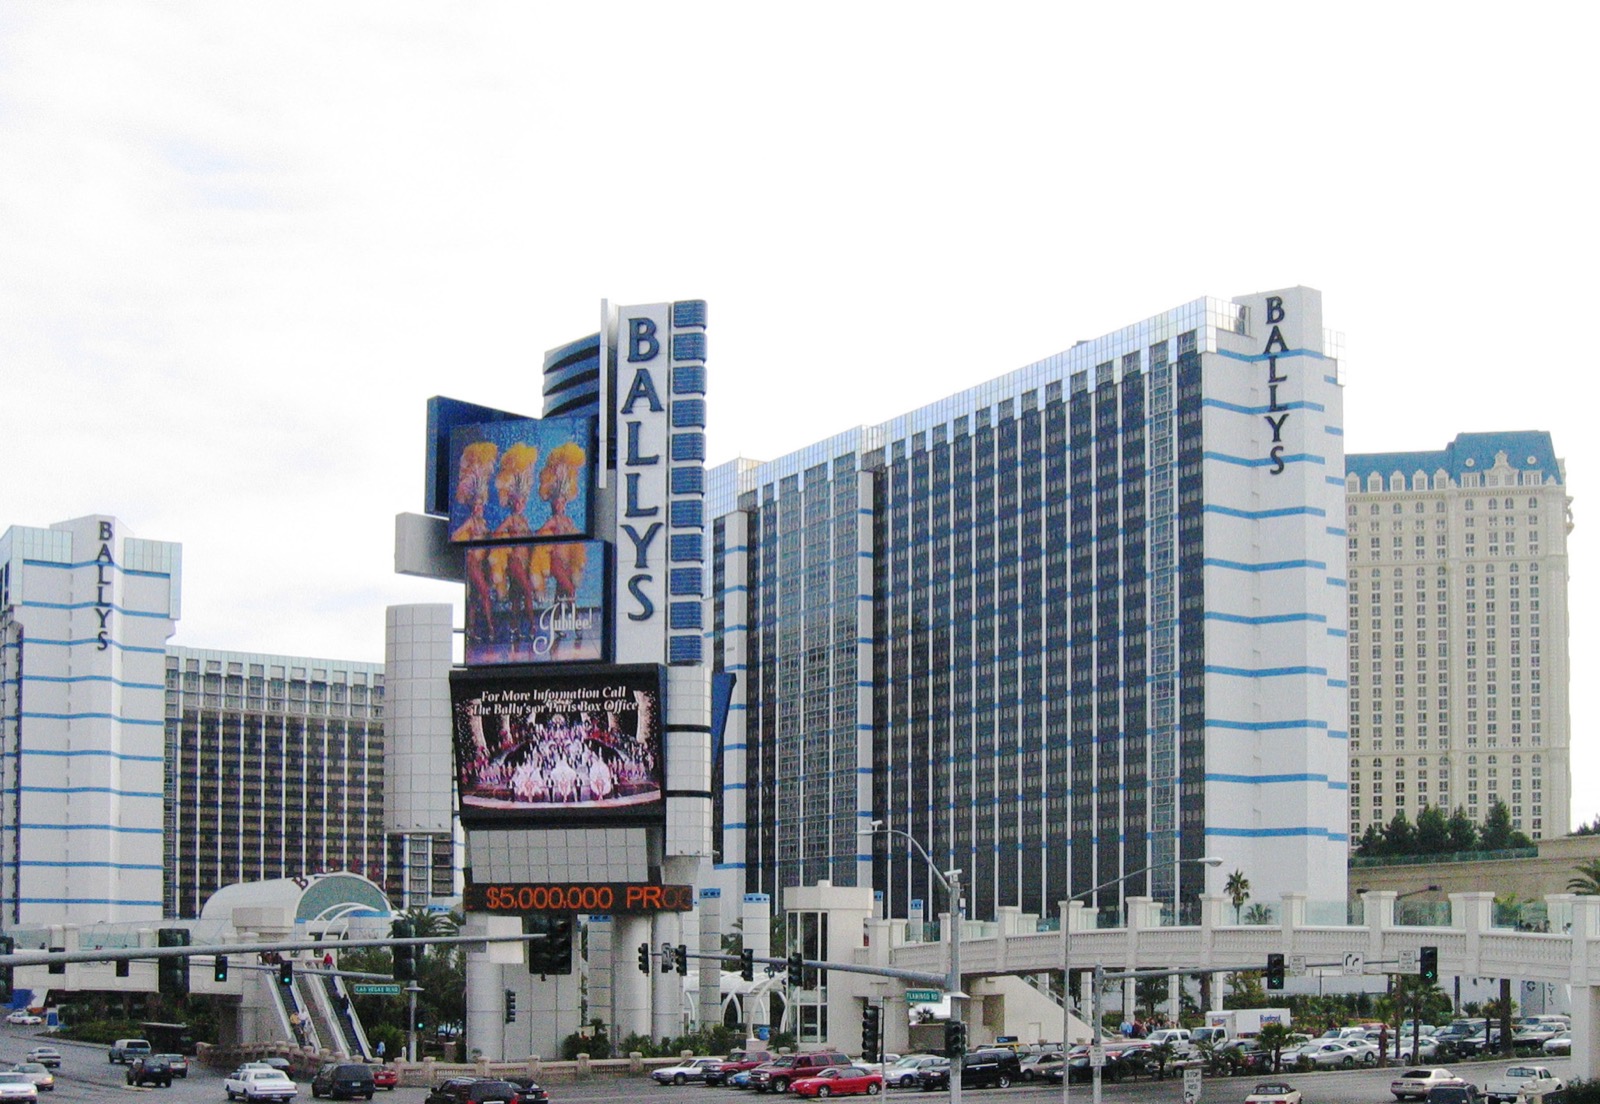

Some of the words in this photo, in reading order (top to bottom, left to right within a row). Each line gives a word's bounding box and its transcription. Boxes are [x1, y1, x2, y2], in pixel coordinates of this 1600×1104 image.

[1263, 296, 1290, 476] BALLYS
[620, 317, 664, 622] BALLYS
[94, 521, 114, 651] BALLYS
[533, 602, 592, 655] Jubilee!
[472, 703, 491, 715] The
[494, 702, 532, 716] Bally's
[534, 704, 546, 713] or
[546, 701, 577, 713] Paris
[578, 701, 601, 712] Box
[603, 699, 638, 715] Office
[481, 690, 500, 702] For
[501, 689, 531, 702] More
[533, 688, 600, 703] Information
[602, 686, 626, 698] Call
[486, 886, 614, 910] $5,000,000
